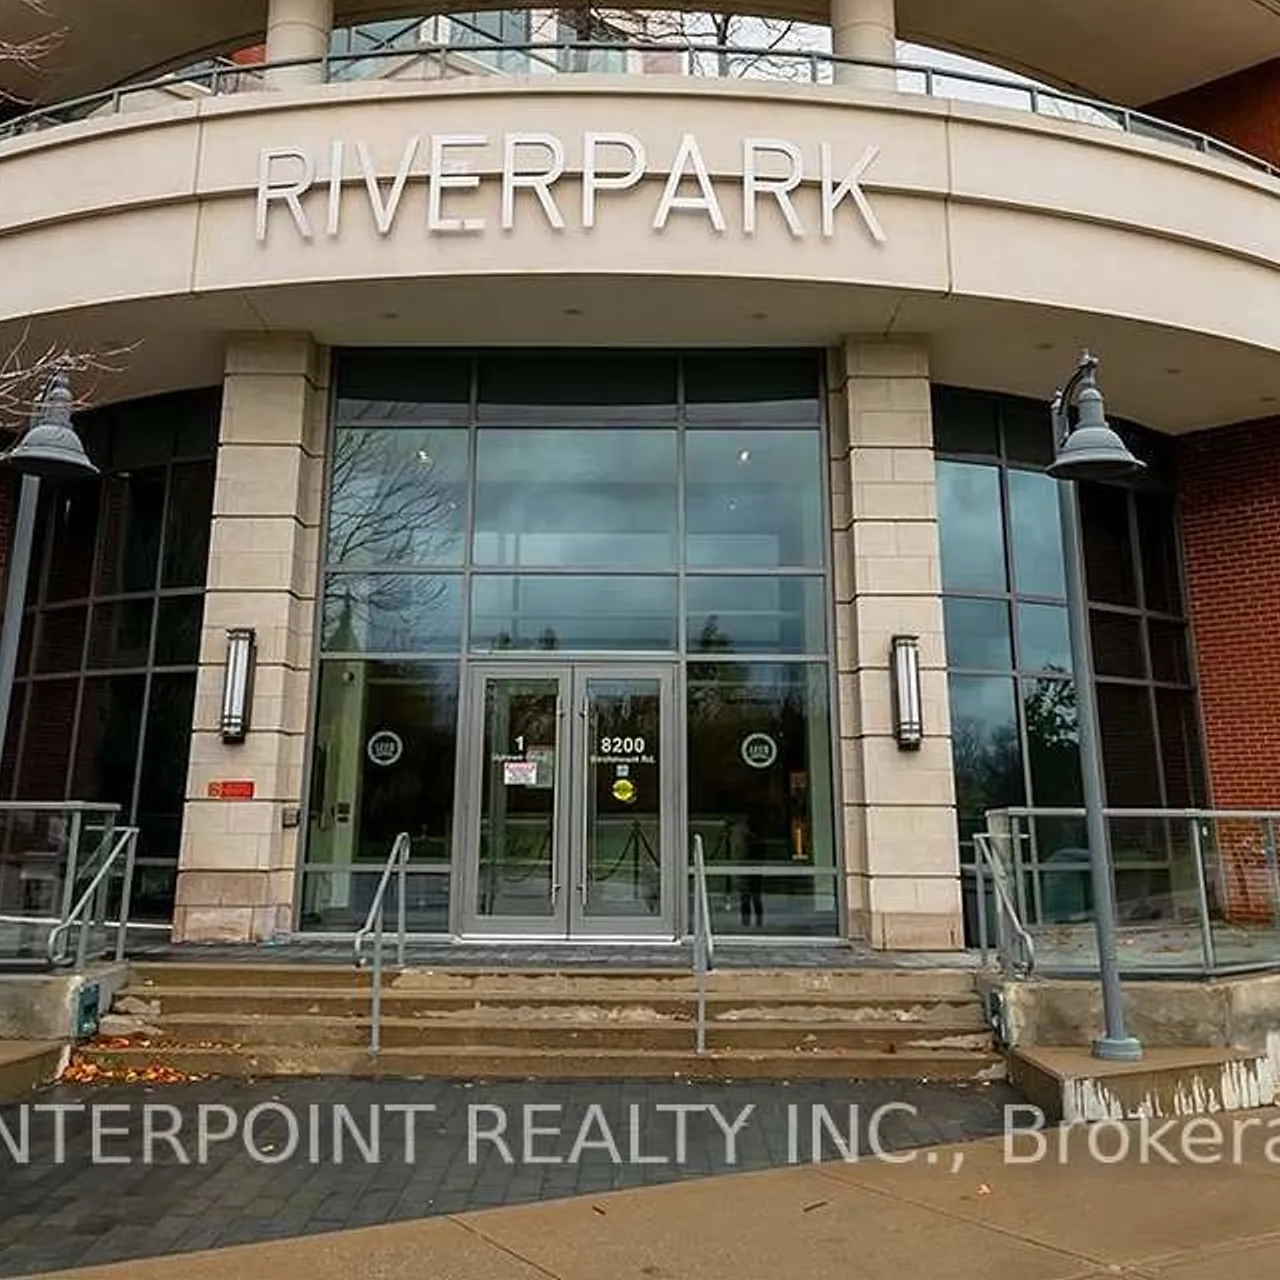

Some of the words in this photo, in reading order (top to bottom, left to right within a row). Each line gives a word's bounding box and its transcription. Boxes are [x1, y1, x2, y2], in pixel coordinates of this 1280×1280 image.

[256, 131, 887, 242] RIVERPARK
[514, 735, 523, 751] 1
[601, 736, 645, 753] 8200
